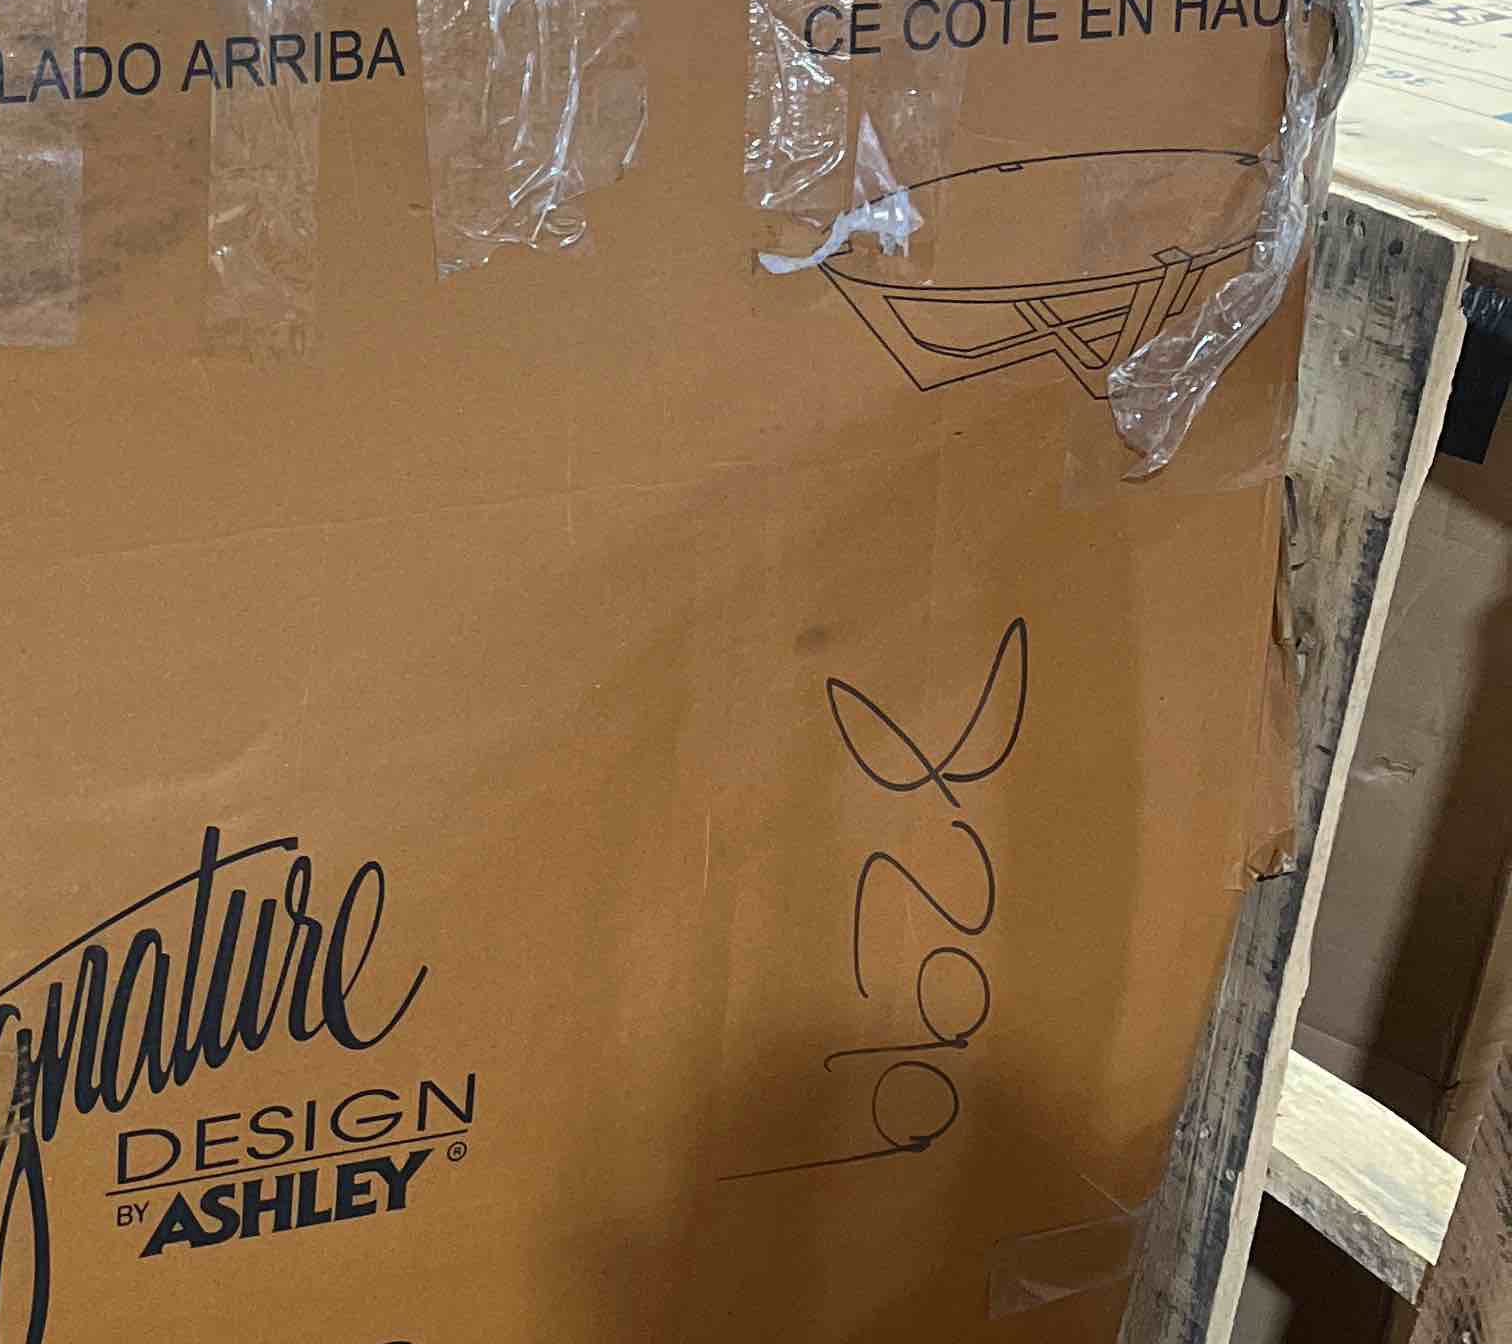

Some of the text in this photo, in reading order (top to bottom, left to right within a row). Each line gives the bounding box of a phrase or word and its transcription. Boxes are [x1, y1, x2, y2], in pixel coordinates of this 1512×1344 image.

[181, 27, 406, 94] ARRIBA
[804, 2, 882, 56] CE
[117, 1073, 476, 1185] DESIGN
[117, 1148, 435, 1258] BY ASHLEY
